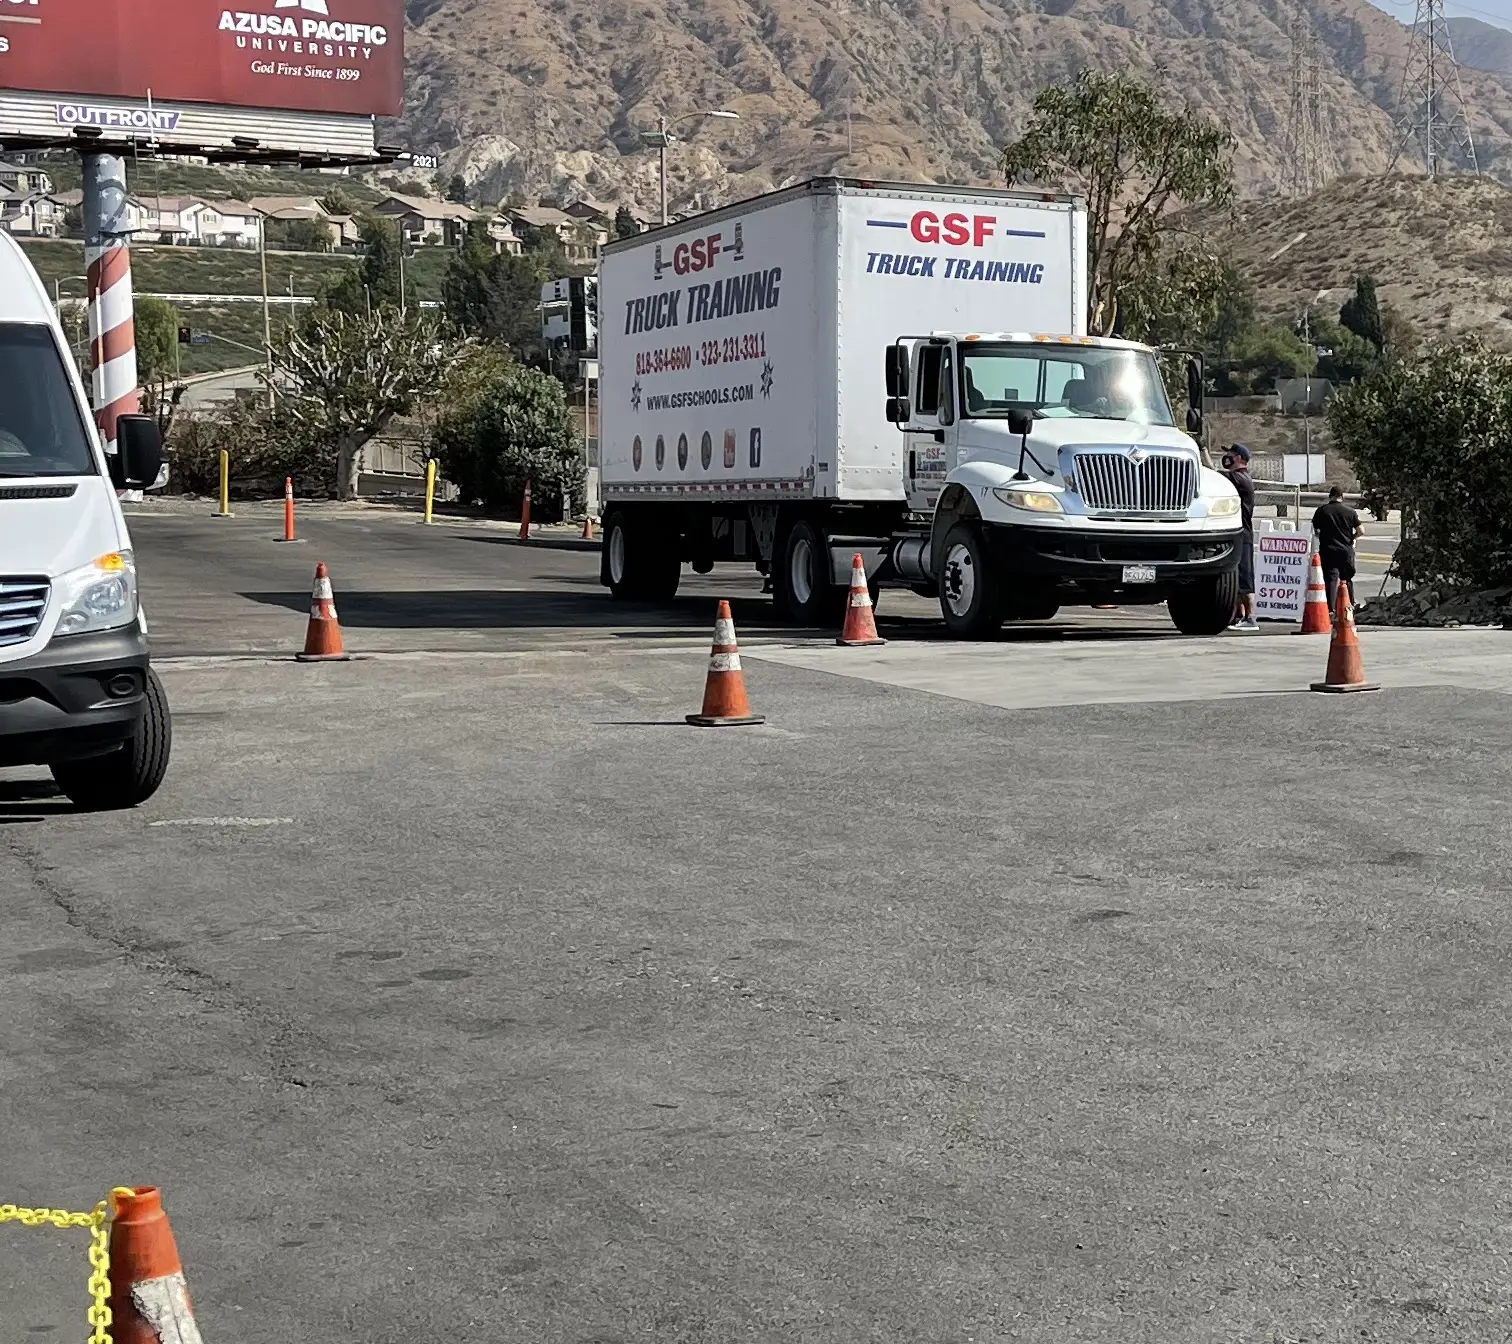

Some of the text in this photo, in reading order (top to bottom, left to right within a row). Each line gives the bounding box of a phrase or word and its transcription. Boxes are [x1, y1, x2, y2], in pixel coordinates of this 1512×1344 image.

[218, 10, 388, 45] AZUSA PACIFIC
[236, 35, 372, 59] UNIVERSITY
[251, 60, 360, 81] God First Since 1899
[61, 106, 175, 129] OUTFRONT
[412, 154, 437, 168] 2021
[910, 211, 996, 247] GSF
[673, 233, 722, 276] GSF
[866, 252, 1045, 284] TRUCK TRAINING
[624, 266, 782, 335] TRUCK TRAINING
[646, 383, 754, 411] WWW.GSFSCHOOLS.COM
[1261, 538, 1307, 553] WARNING
[1263, 554, 1303, 566] VEHICLES
[1277, 566, 1287, 574] IN
[1260, 574, 1301, 585] TRAINING
[1259, 587, 1299, 600] STOP!
[1270, 601, 1299, 611] SCHOOLS
